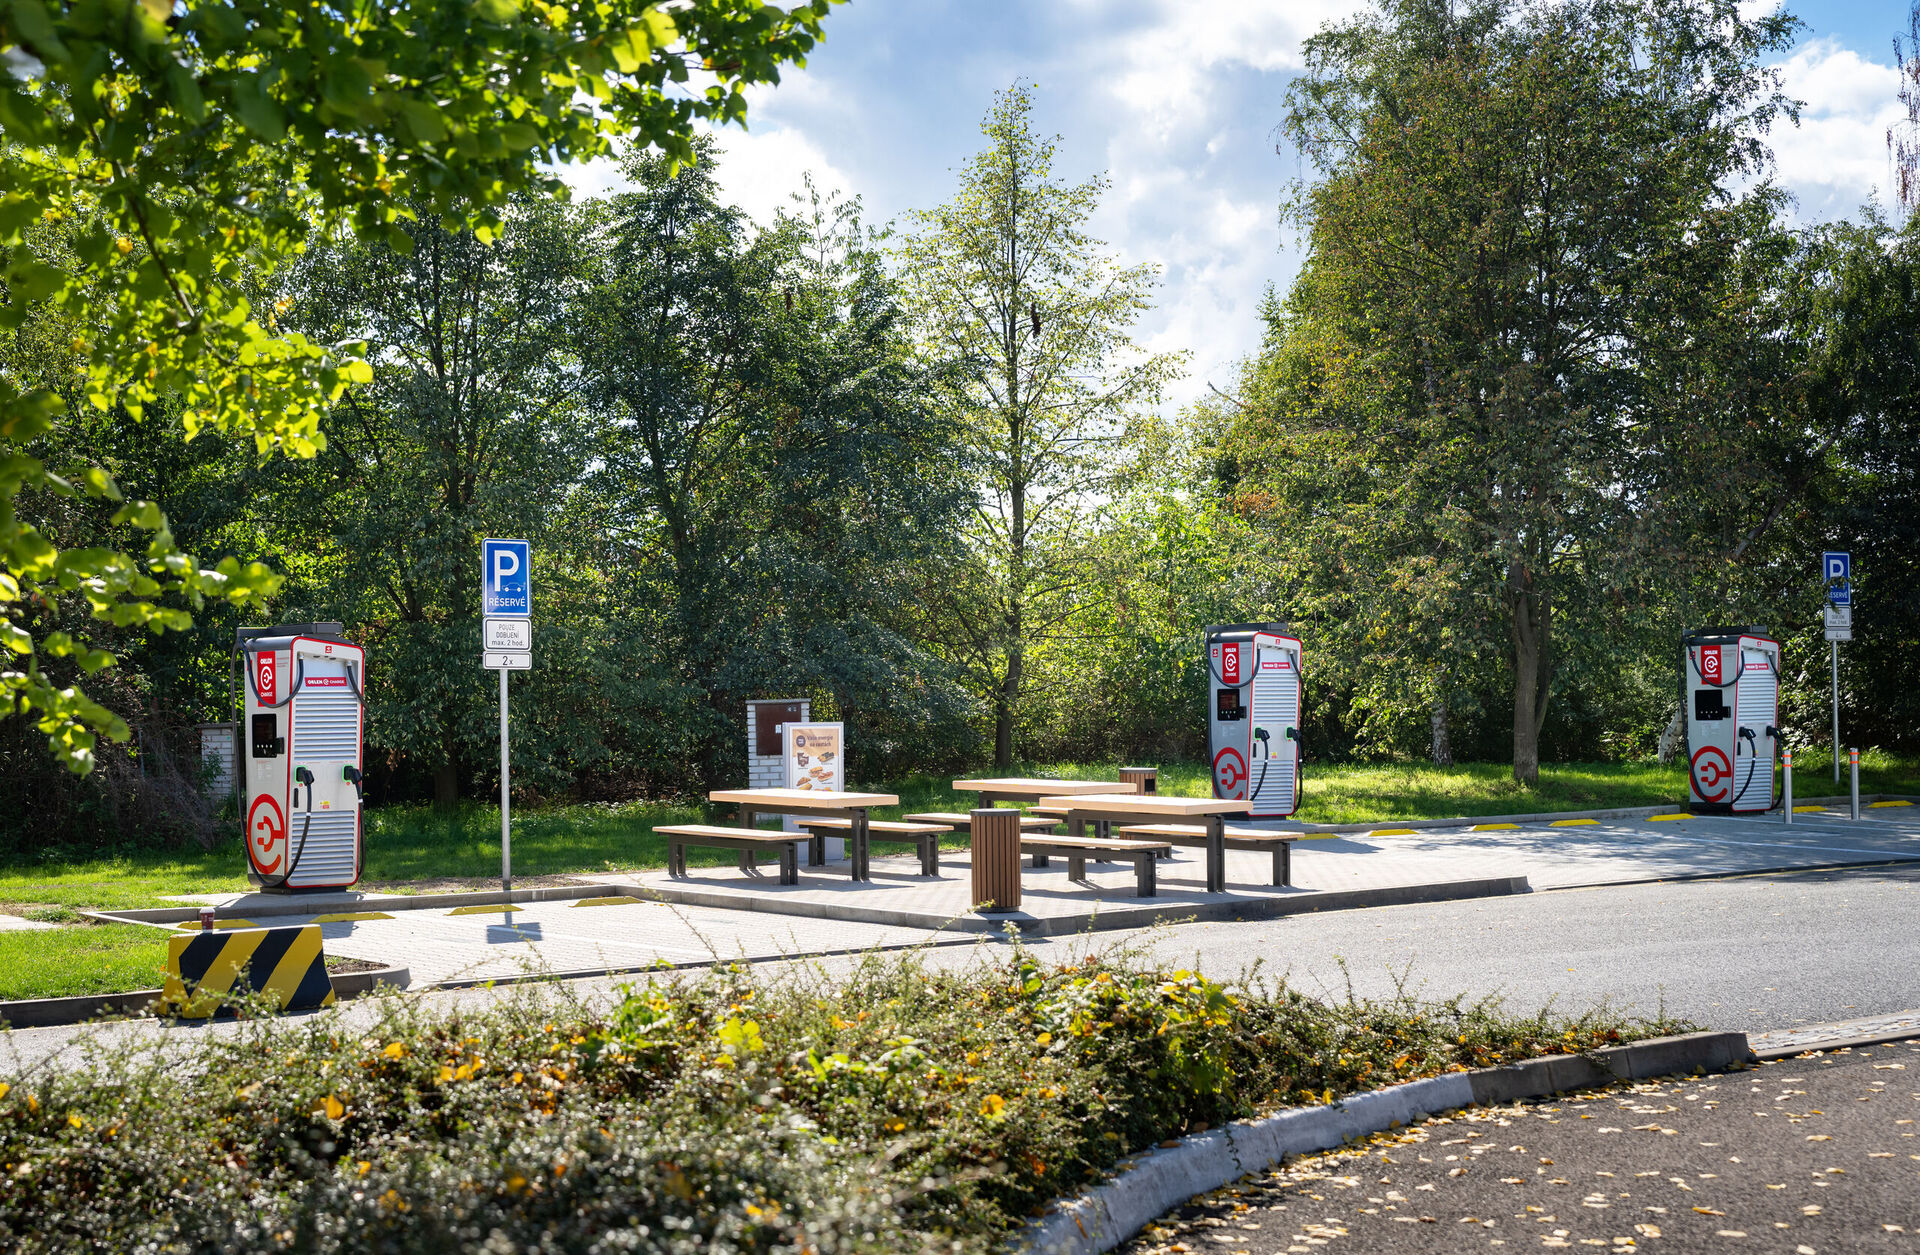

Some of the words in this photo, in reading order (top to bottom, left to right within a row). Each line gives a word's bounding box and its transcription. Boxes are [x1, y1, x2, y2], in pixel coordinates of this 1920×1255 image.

[494, 550, 519, 592] P
[1830, 560, 1844, 582] P
[488, 596, 526, 607] RÉSERVÉ
